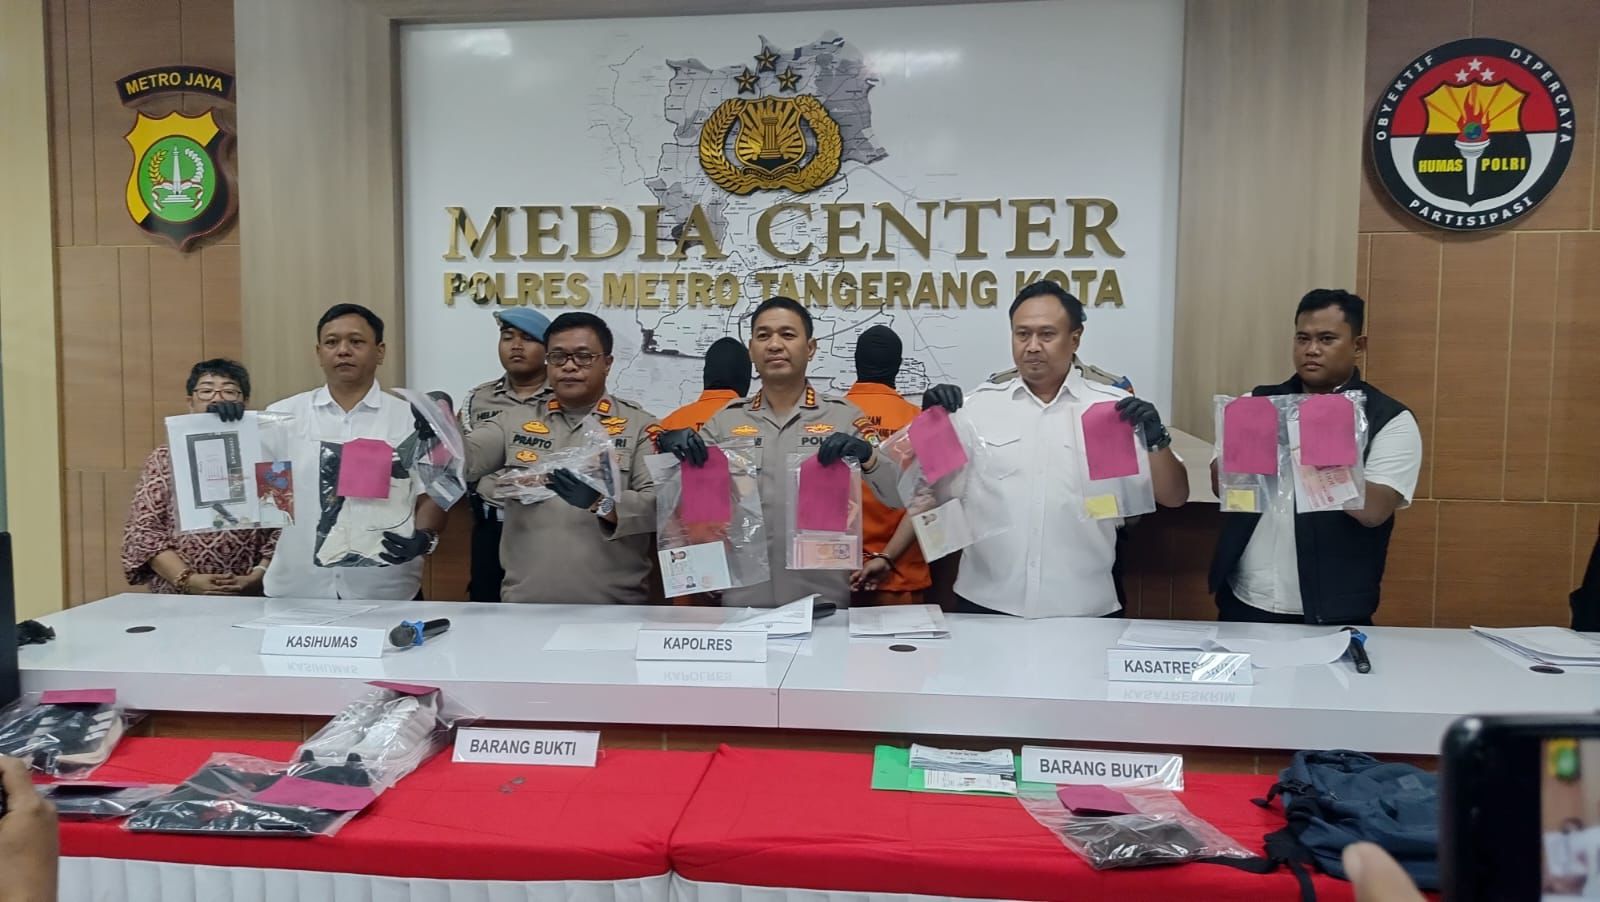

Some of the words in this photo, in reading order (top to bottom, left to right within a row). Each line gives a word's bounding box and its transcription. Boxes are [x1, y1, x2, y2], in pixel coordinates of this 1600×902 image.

[125, 72, 180, 94] METRO
[185, 72, 223, 92] JAYA
[1376, 55, 1434, 141] OBYEKTIF
[1509, 48, 1572, 143] DIPERCAYA
[1418, 159, 1463, 173] HUMAS
[1481, 157, 1526, 171] POLRI
[1409, 198, 1533, 226] PARTISIPASI
[442, 204, 727, 262] MEDIA
[756, 197, 1126, 260] CENTER
[443, 272, 590, 307] POLRES
[603, 272, 740, 308] METRO
[755, 269, 998, 310] TANGERANG
[513, 433, 552, 449] PRAPTO
[286, 635, 358, 649] KASIHUMAS
[663, 636, 733, 651] KAPOLRES
[470, 739, 530, 754] BARANG
[533, 741, 576, 756] BUKTI
[1040, 758, 1106, 776] BARANG
[1111, 763, 1158, 779] BUKTI
